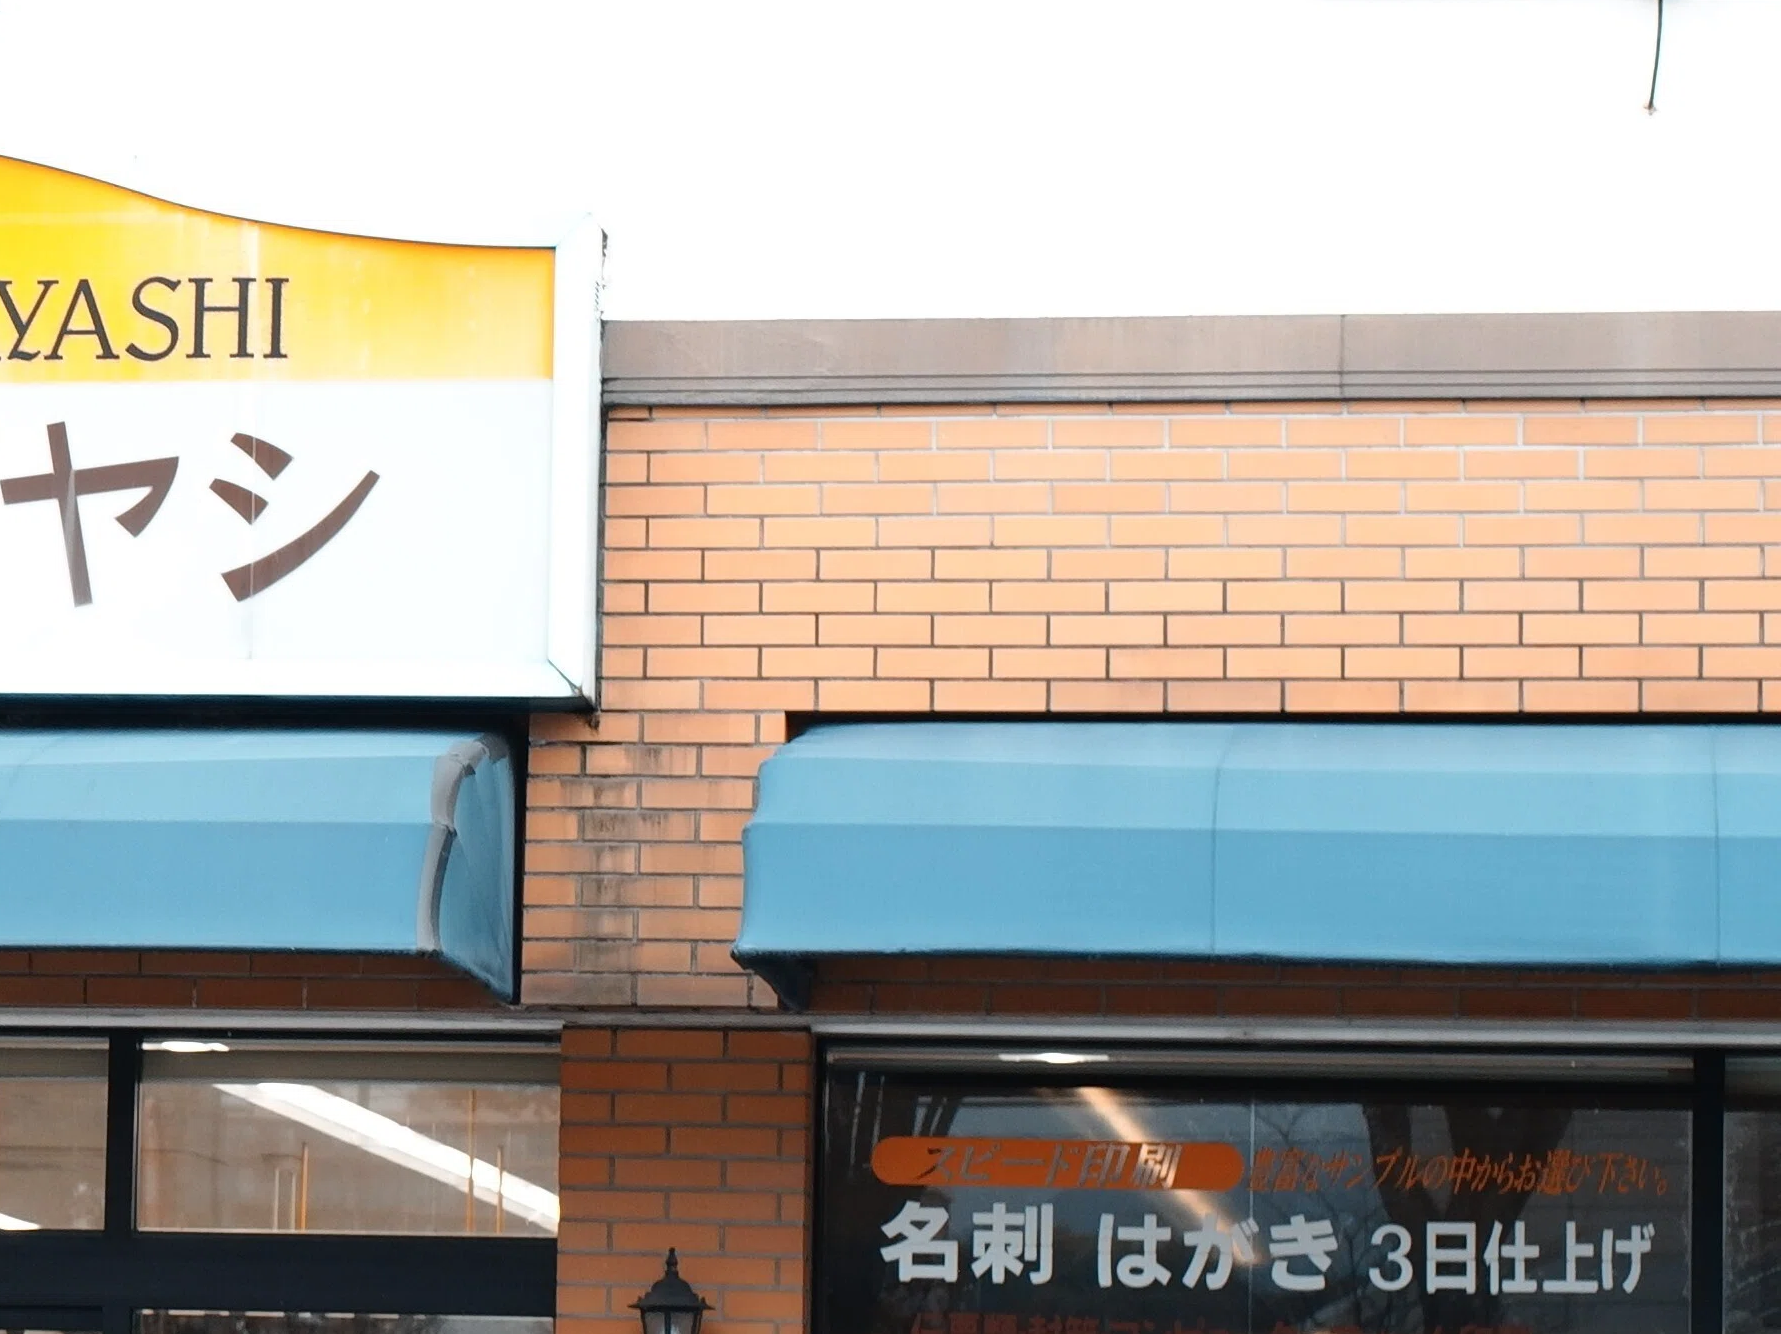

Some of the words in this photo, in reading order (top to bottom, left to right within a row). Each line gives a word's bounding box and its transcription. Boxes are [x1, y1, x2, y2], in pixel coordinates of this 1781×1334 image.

[917, 1143, 1183, 1189] スピード印刷
[1248, 1147, 1668, 1196] 豊富なサンプルの中からお選び下さい。
[880, 1201, 1054, 1285] 名刺
[1097, 1213, 1338, 1292] はがき
[1368, 1220, 1655, 1296] 3日仕上げ
